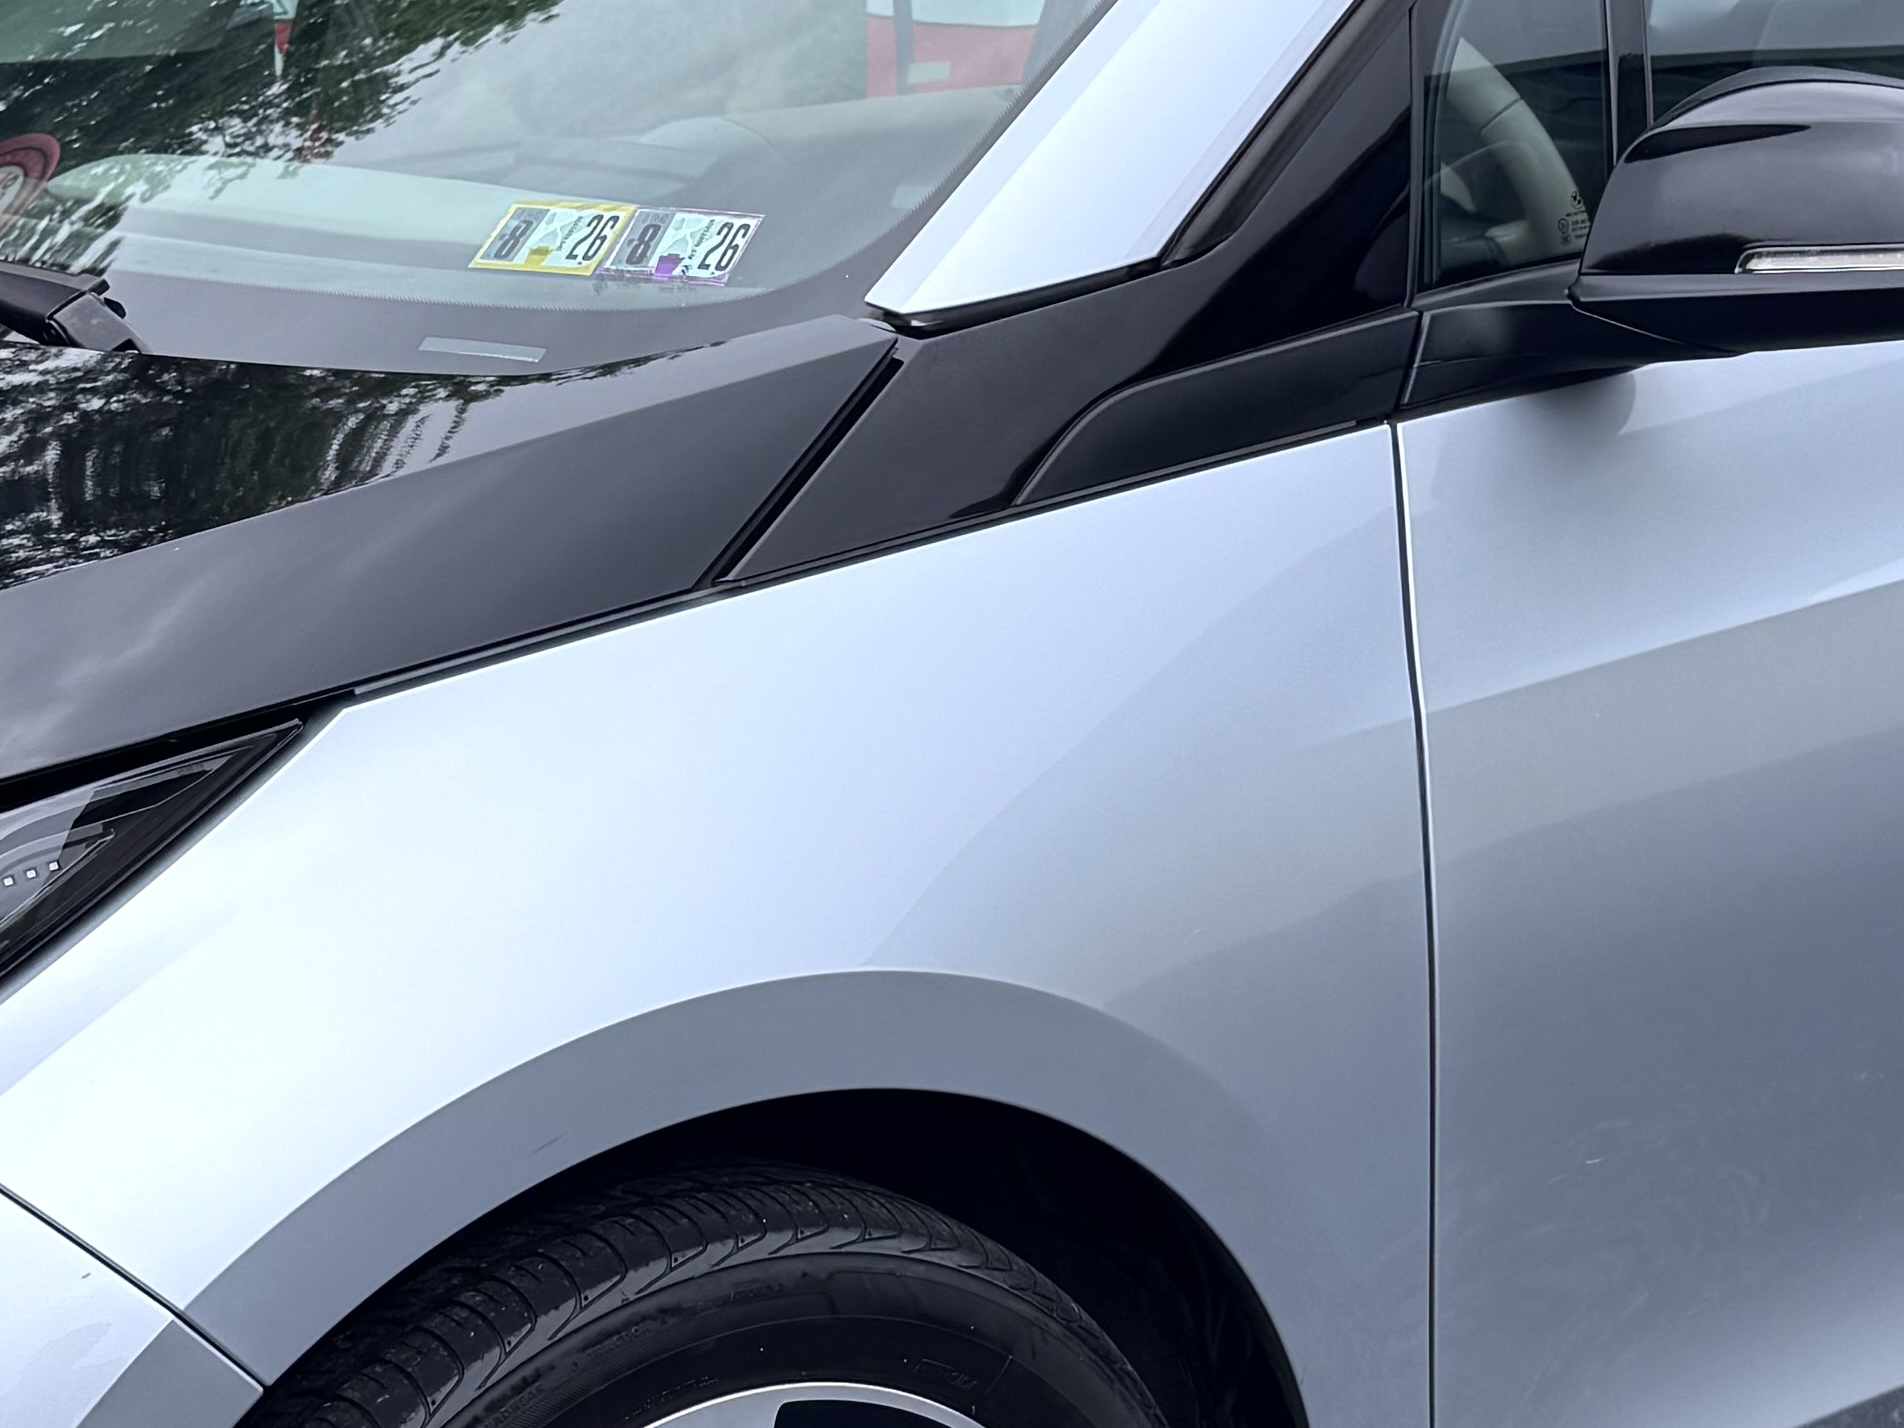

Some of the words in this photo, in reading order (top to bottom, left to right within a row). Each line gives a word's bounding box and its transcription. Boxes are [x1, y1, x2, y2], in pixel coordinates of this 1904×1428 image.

[493, 219, 534, 260] 8
[565, 213, 620, 262] 26
[626, 223, 662, 265] 8
[697, 221, 751, 272] 26
